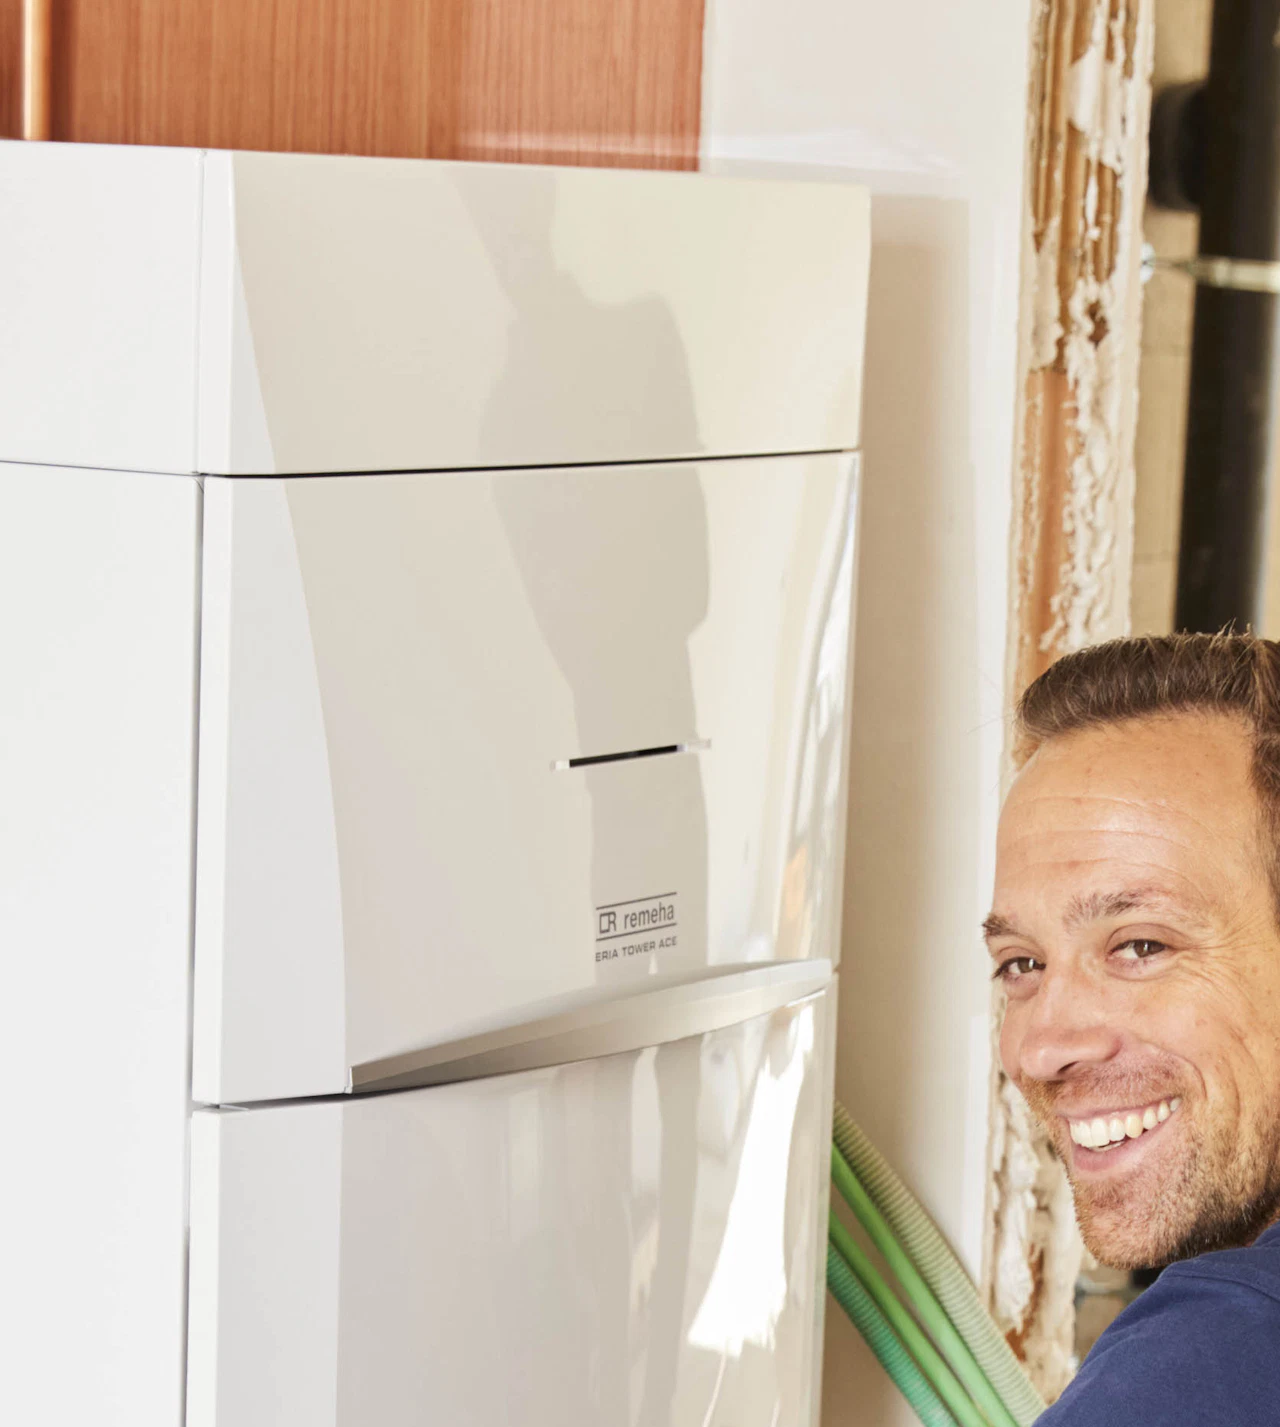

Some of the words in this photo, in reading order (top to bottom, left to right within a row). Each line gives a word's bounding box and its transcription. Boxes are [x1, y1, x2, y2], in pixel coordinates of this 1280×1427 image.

[624, 902, 675, 930] remeha
[622, 941, 656, 957] TOWER
[658, 936, 677, 950] ACE
